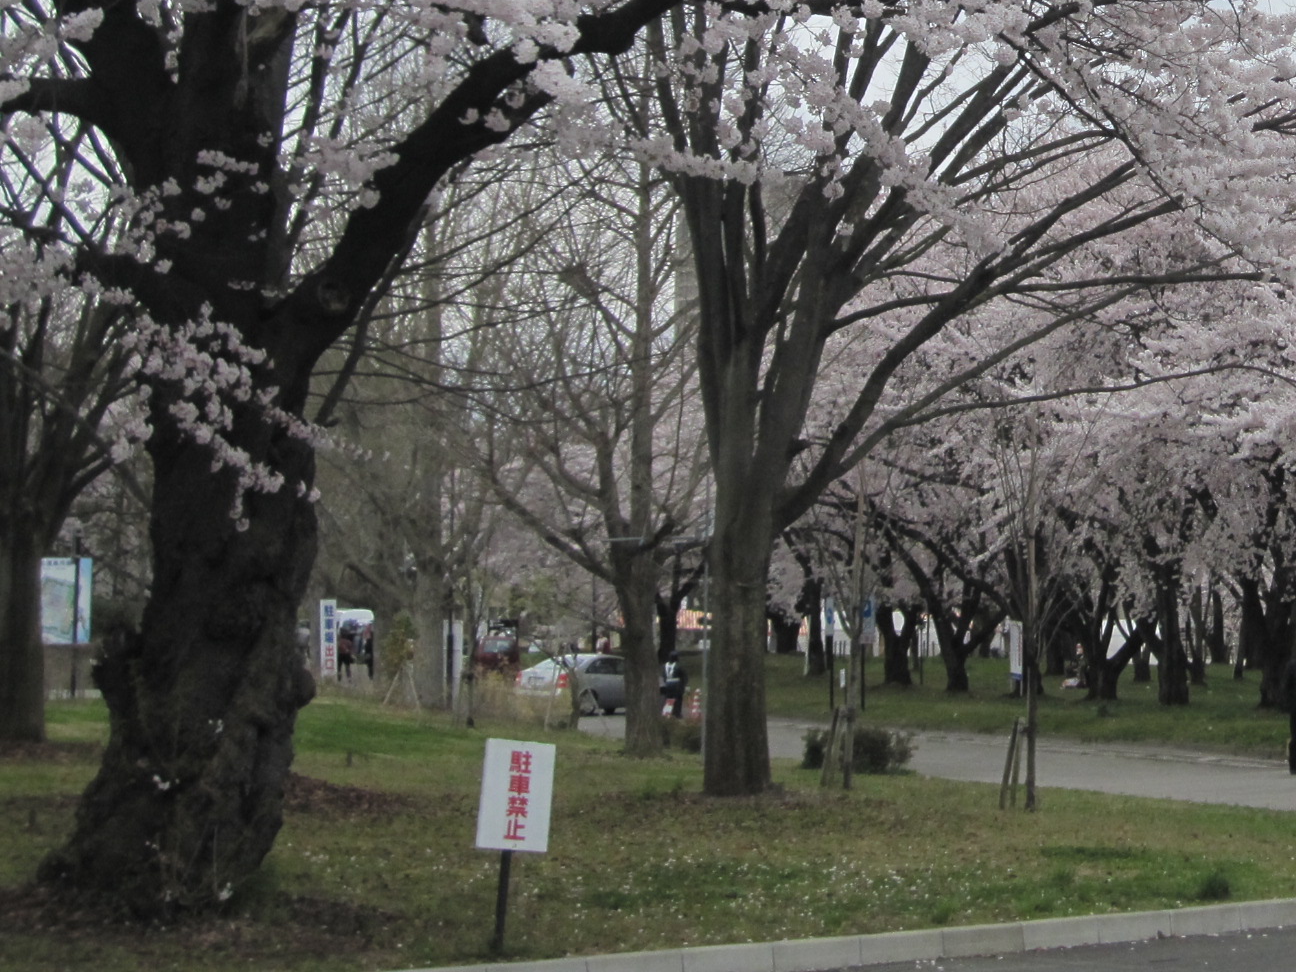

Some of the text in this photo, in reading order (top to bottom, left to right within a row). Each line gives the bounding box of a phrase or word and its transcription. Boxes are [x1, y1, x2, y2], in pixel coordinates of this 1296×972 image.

[324, 605, 334, 670] 駐車場出口
[503, 750, 532, 841] 駐車禁止
